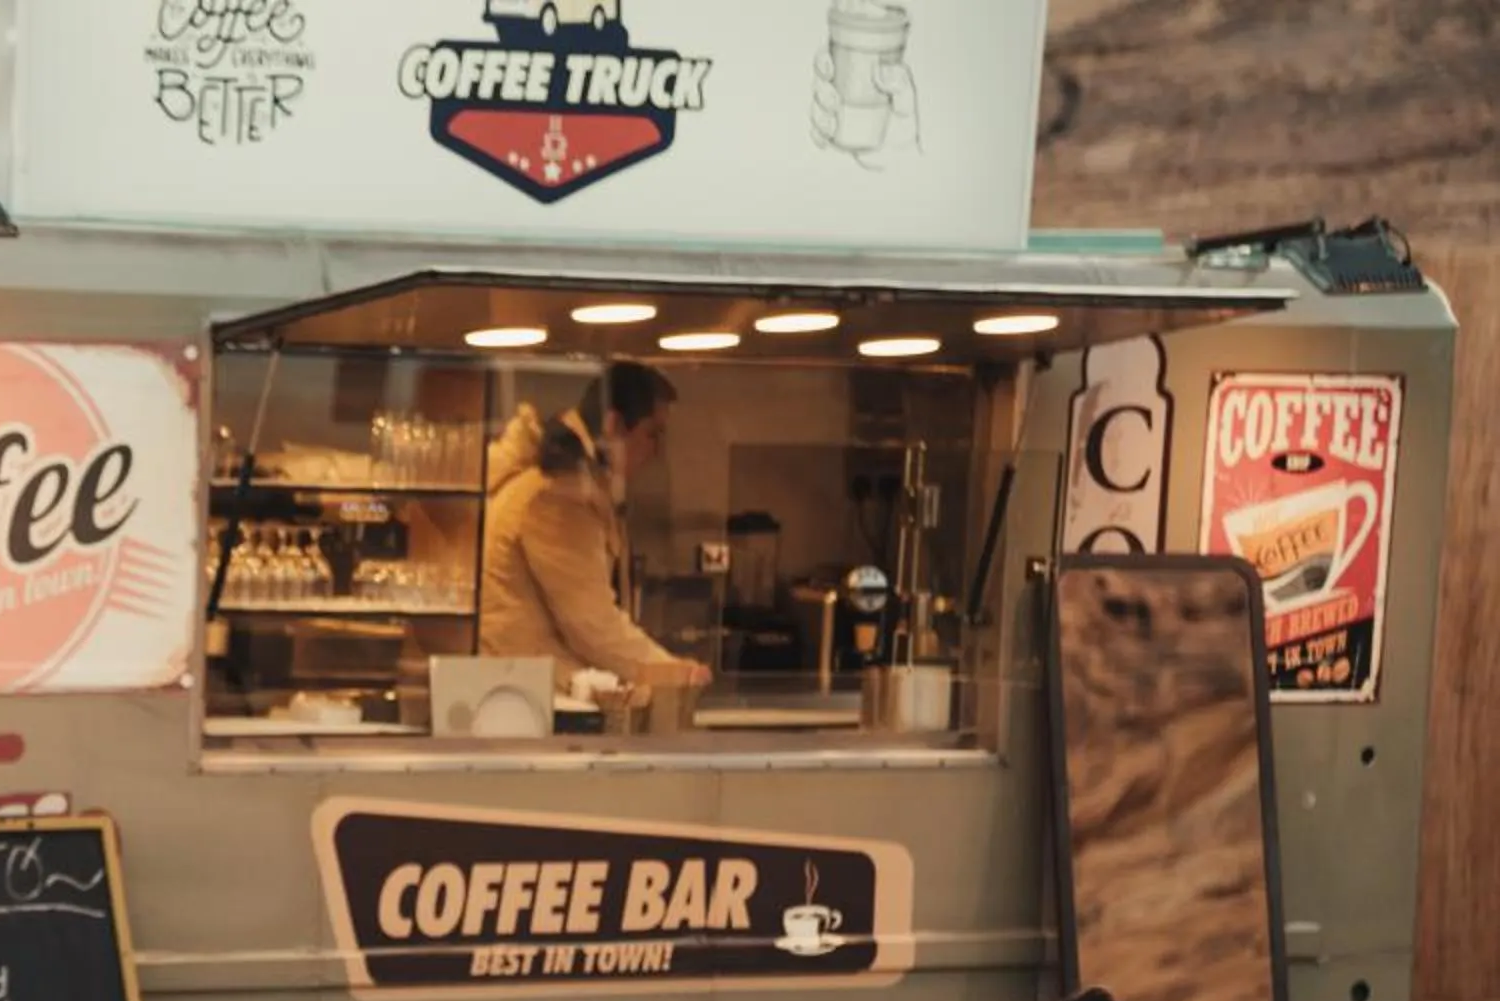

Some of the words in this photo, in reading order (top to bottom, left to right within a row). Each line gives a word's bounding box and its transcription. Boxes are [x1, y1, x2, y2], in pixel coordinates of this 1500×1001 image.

[155, 67, 304, 145] BETTER
[399, 46, 556, 101] COFFEE
[565, 54, 712, 109] TRUCK
[1219, 388, 1388, 470] COFFEE
[377, 860, 609, 940] COFFEE
[621, 857, 759, 932] BAR
[470, 946, 537, 977] BEST
[543, 944, 577, 975] IN
[581, 942, 674, 974] TOWN!
